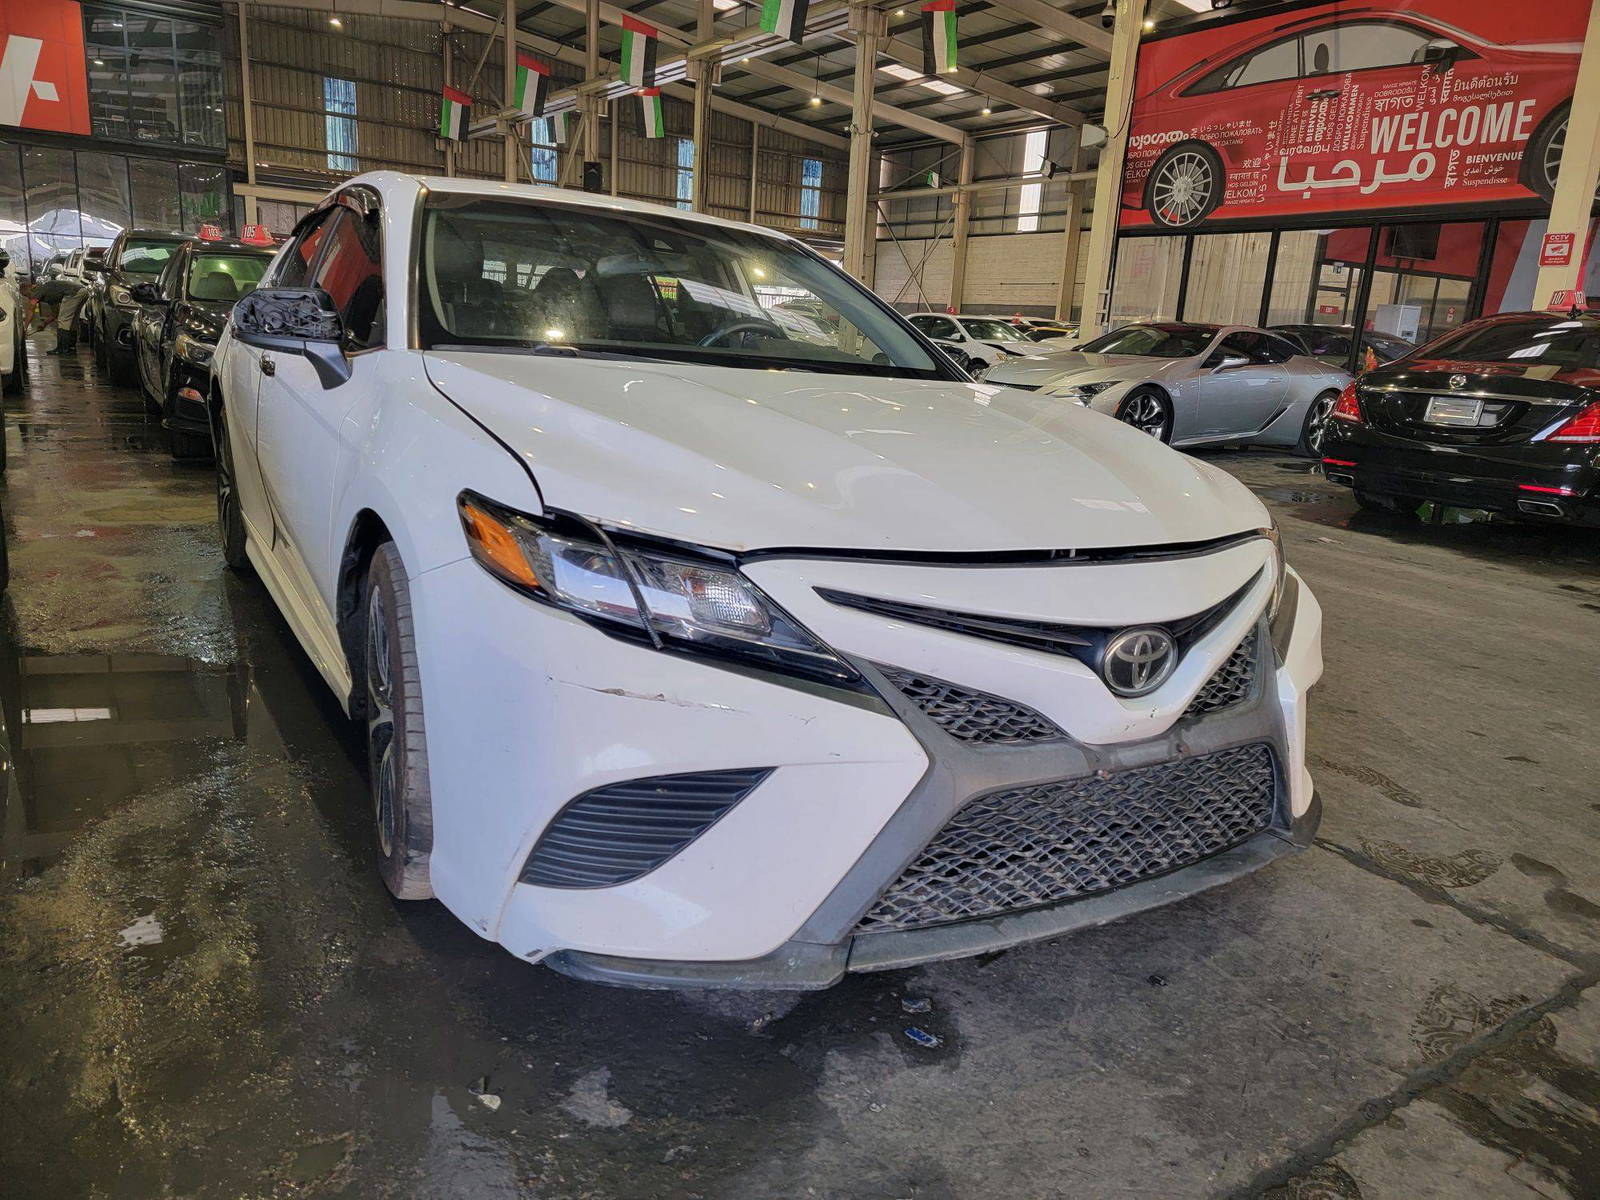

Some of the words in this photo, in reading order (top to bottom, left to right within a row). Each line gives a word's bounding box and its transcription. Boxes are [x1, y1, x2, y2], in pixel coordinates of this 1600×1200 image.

[1415, 64, 1431, 112] WELKOM
[1329, 98, 1339, 119] GELD
[1342, 84, 1359, 151] WILLKOMMEN
[1357, 96, 1373, 149] Suspendisse
[1371, 98, 1536, 154] WELCOME
[1333, 124, 1344, 151] ДОБРО
[1466, 151, 1524, 164] BIENVENUE
[1125, 169, 1150, 179] ELKO
[1277, 152, 1436, 199] مرحبا
[1462, 176, 1508, 187] Suspendisse
[244, 226, 256, 239] 105
[1551, 292, 1566, 305] 107
